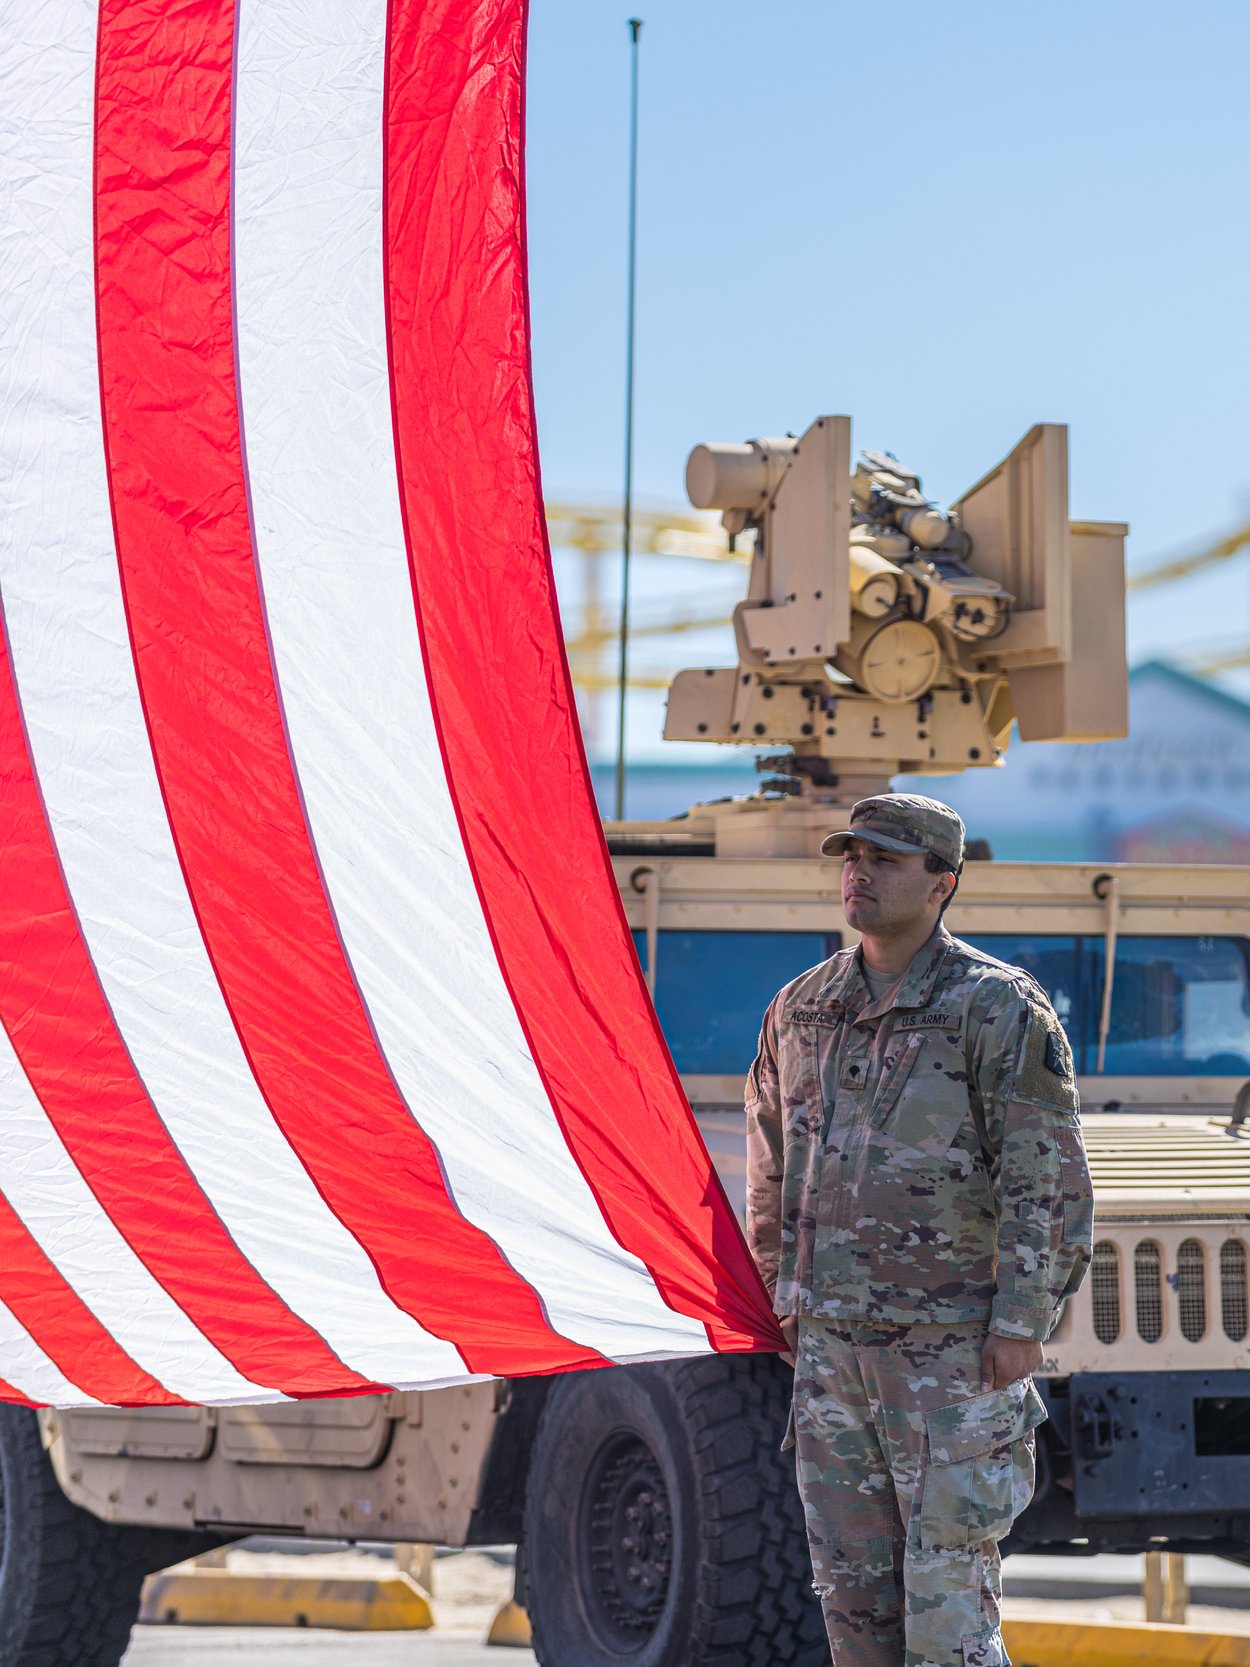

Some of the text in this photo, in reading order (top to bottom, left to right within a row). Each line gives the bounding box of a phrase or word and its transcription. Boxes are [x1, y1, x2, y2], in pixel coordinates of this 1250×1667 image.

[790, 1010, 823, 1023] ACOSTA
[901, 1014, 949, 1027] U.S. ARMY
